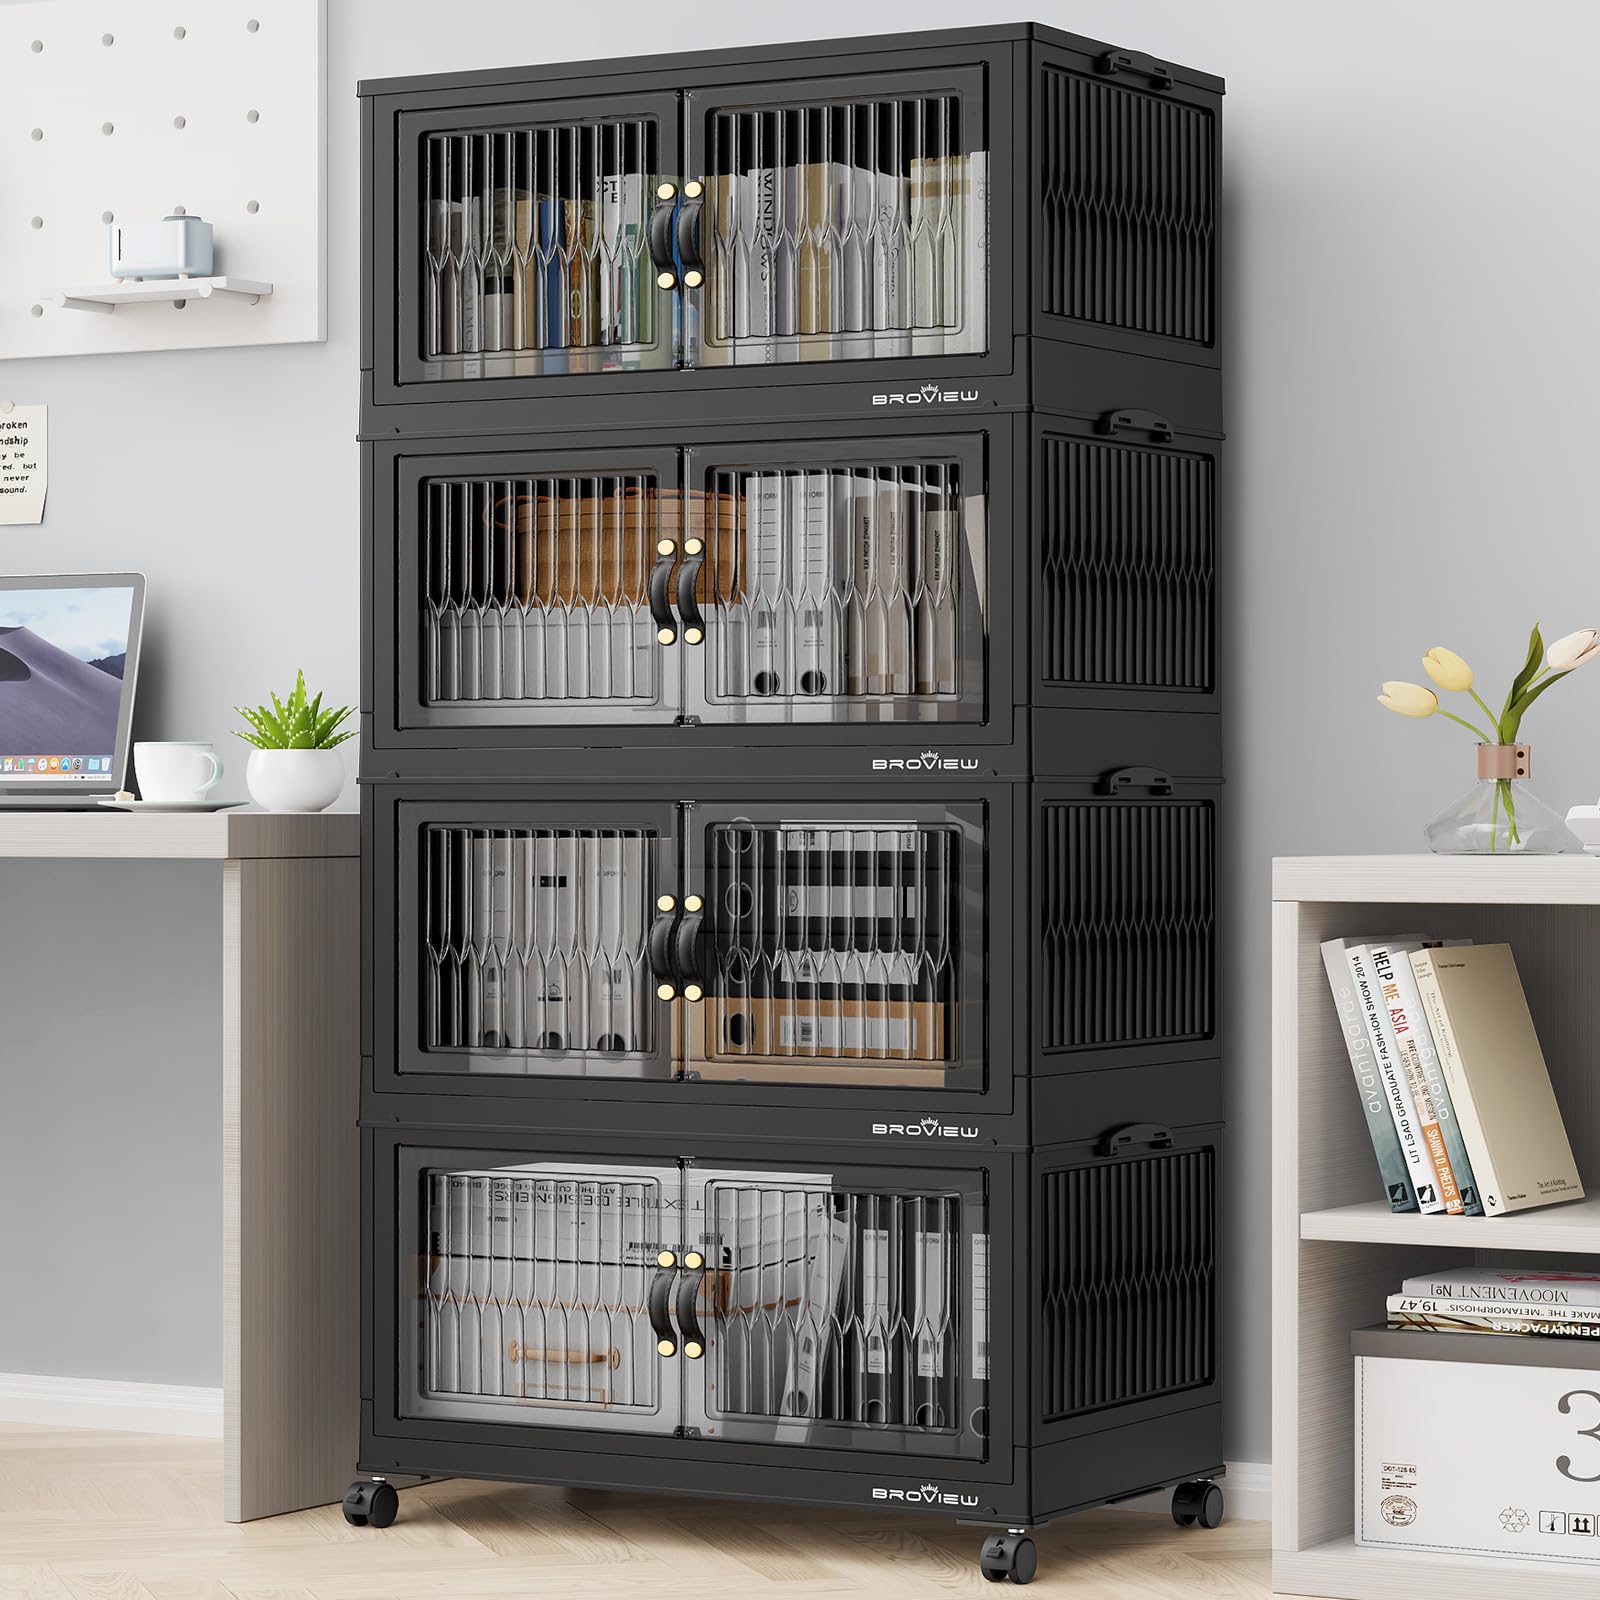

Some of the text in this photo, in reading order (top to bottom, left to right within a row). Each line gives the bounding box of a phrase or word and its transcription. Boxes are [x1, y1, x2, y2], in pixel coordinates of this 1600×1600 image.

[872, 387, 978, 405] BROVIEW
[0, 421, 28, 430] roken
[872, 756, 978, 770] BROVIEW
[1372, 951, 1394, 980] HELP
[1389, 1008, 1409, 1035] ASIA
[1337, 986, 1382, 1113] avantgarde
[1352, 956, 1420, 1164] LIT LSAD GRADUATE FASH-ION SHOW 2014
[872, 1121, 978, 1138] BROVIEW
[1426, 1129, 1442, 1158] SHAWN
[1438, 1166, 1456, 1197] PHELPS
[1457, 1286, 1569, 1303] MOOVEMENT
[1399, 1299, 1438, 1312] 19,47
[1571, 1311, 1600, 1319] MAKE
[1491, 1321, 1600, 1337] PENNYPACKER
[1556, 1389, 1600, 1482] 3
[872, 1486, 978, 1506] BROVIEW
